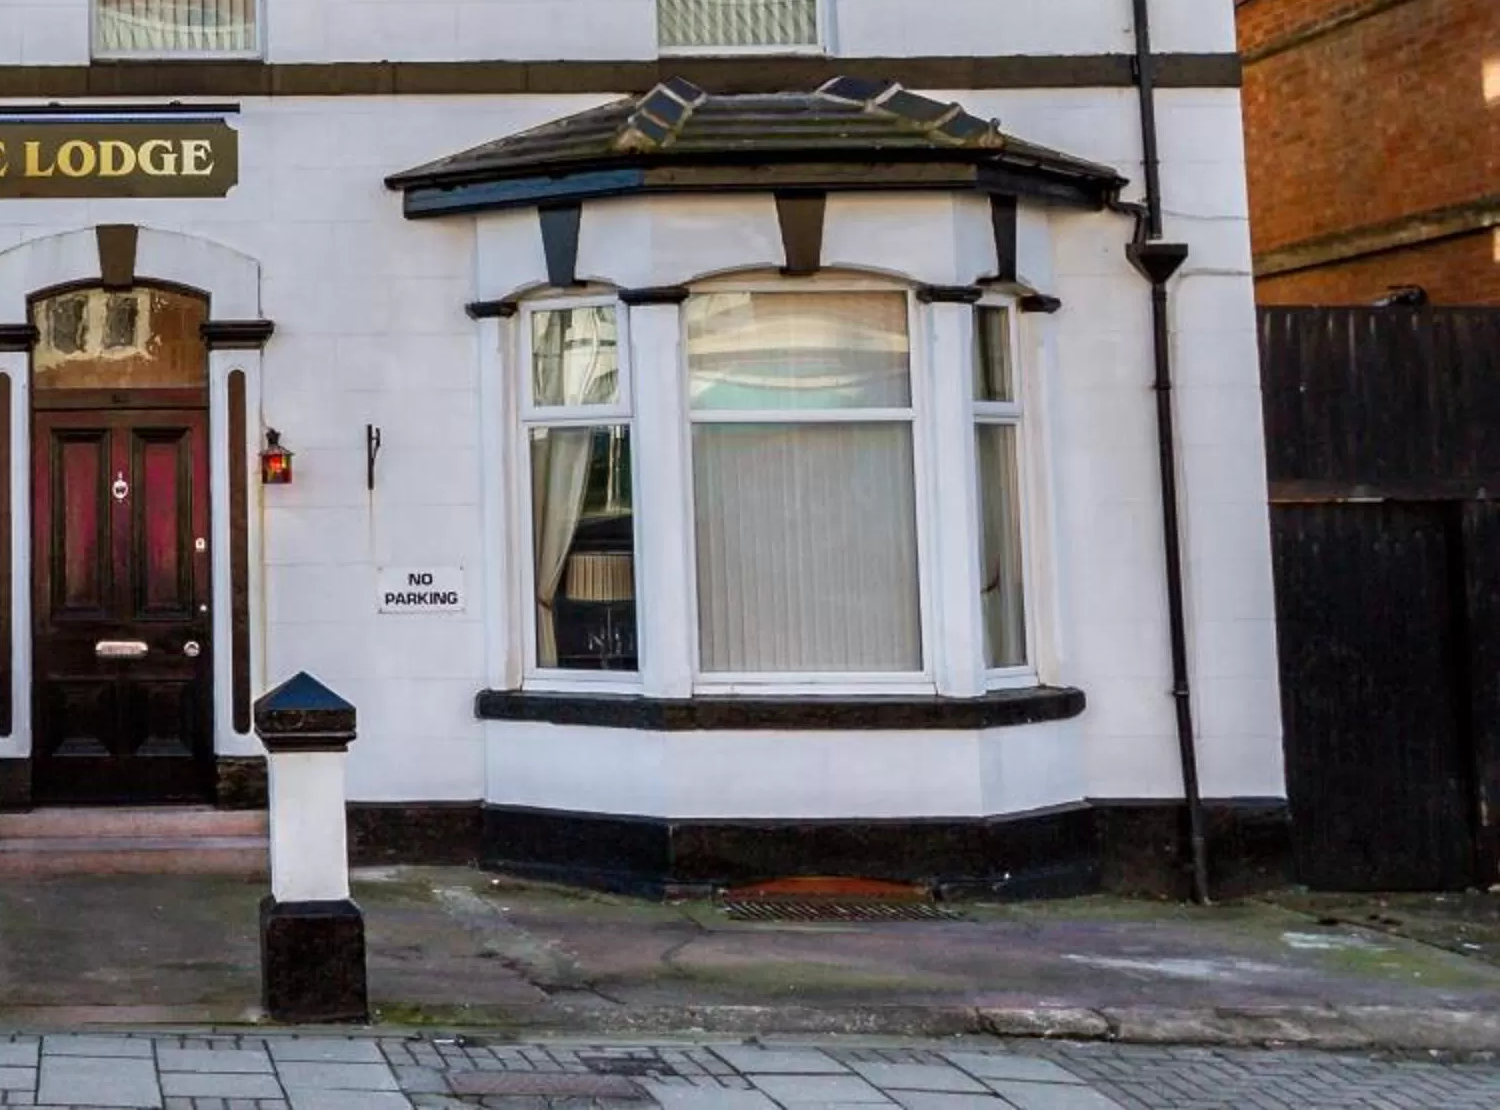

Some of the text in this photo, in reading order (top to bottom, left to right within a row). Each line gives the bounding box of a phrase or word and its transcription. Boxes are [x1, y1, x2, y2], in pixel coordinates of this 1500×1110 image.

[25, 138, 215, 178] LODGE
[408, 573, 433, 586] NO
[385, 591, 458, 605] PARKING
